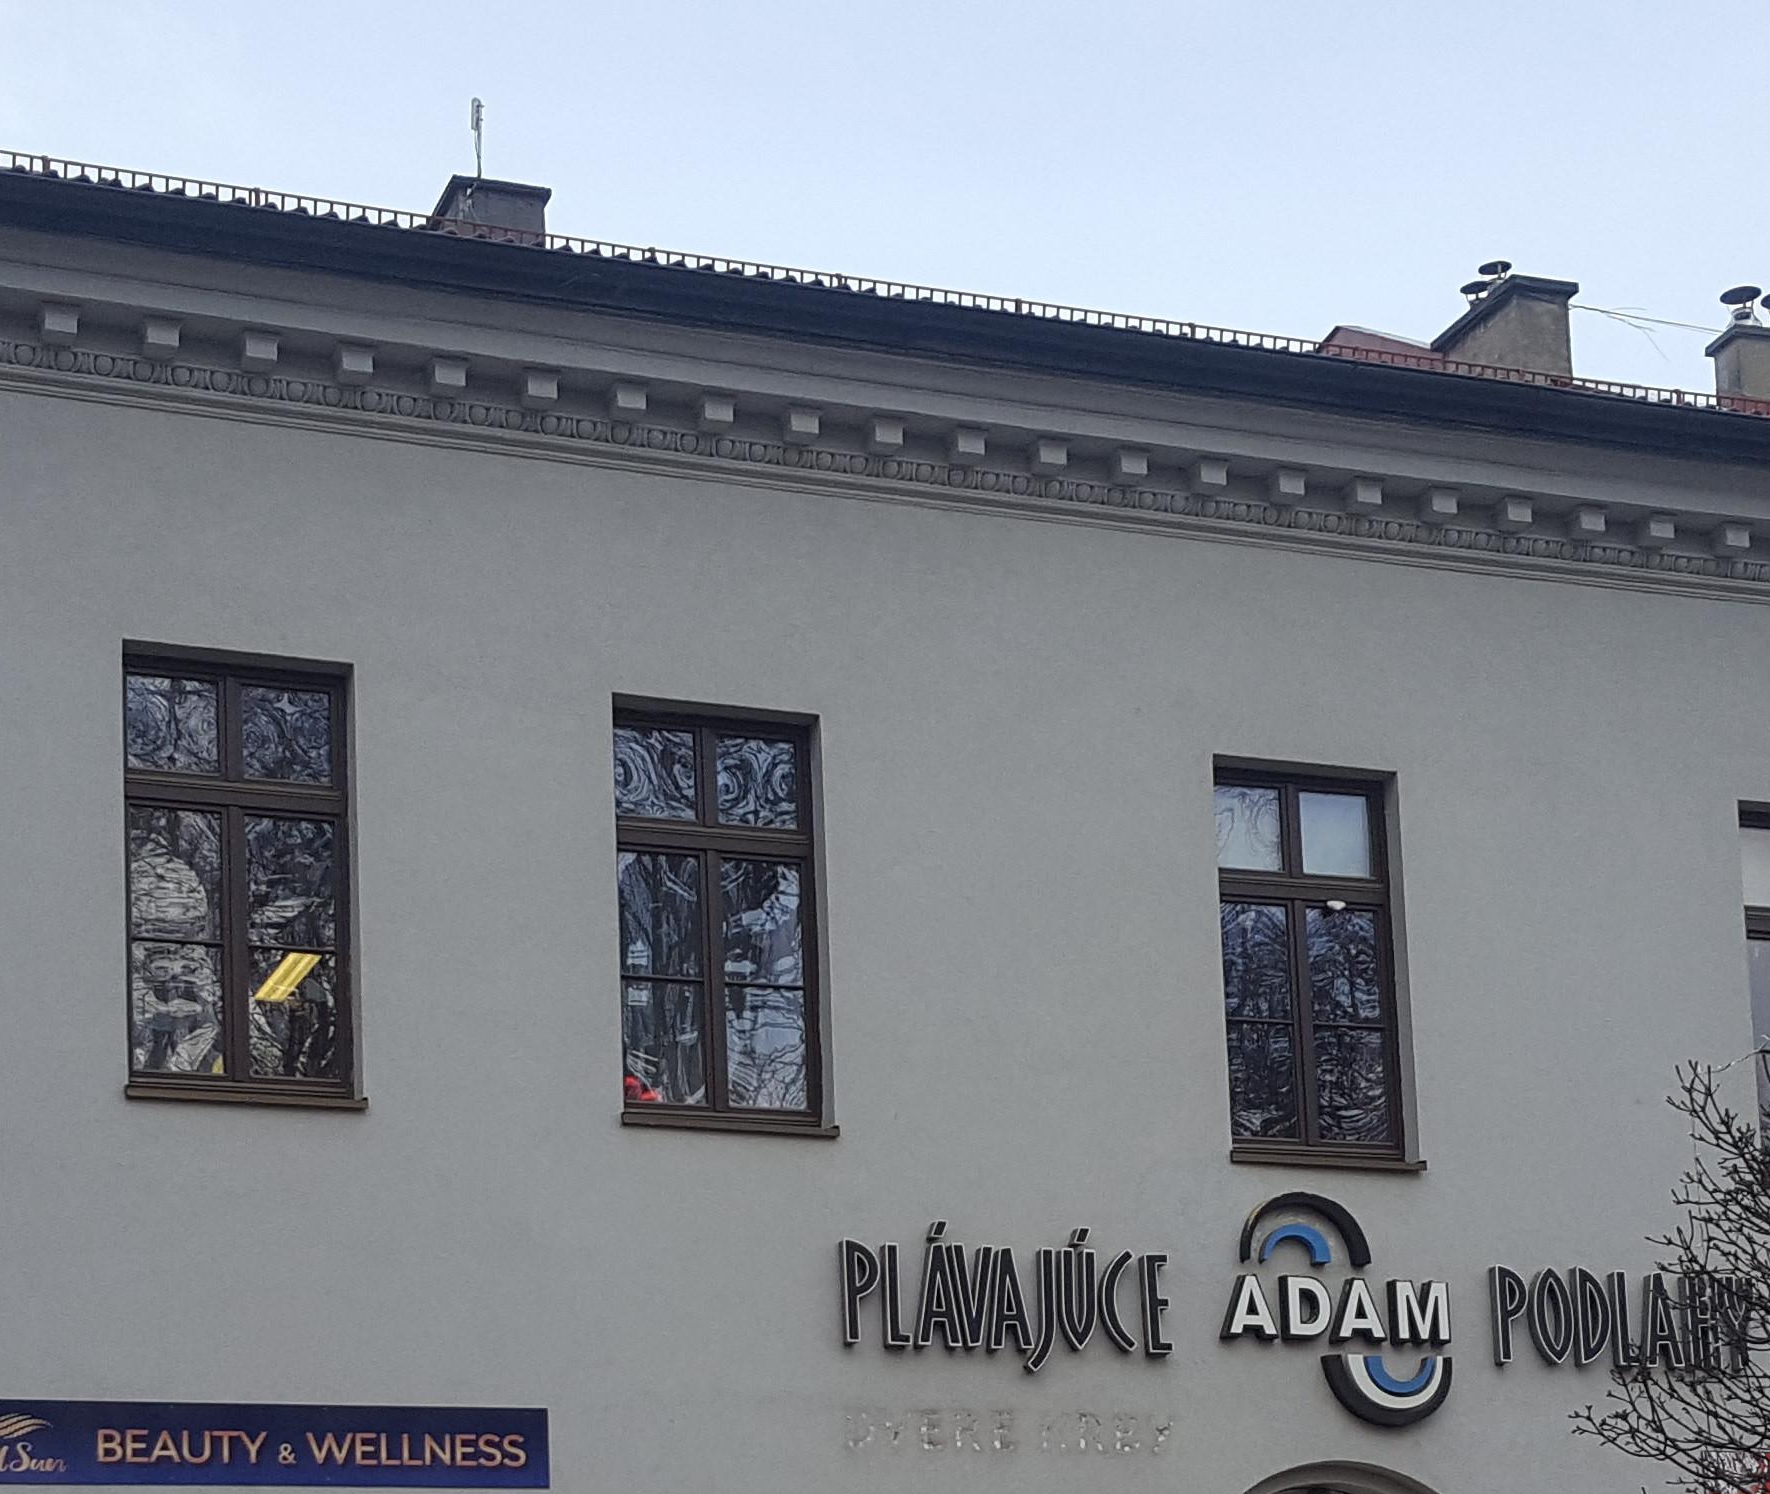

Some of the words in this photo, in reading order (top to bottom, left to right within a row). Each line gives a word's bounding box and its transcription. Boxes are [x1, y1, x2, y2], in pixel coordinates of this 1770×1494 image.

[837, 1218, 1175, 1374] PLÁVAJÚCE
[1219, 1272, 1452, 1347] ADAM
[1487, 1263, 1754, 1374] PODLAHY
[95, 1428, 268, 1465] BEAUTY
[277, 1442, 297, 1465] &
[305, 1431, 528, 1468] WELLNESS
